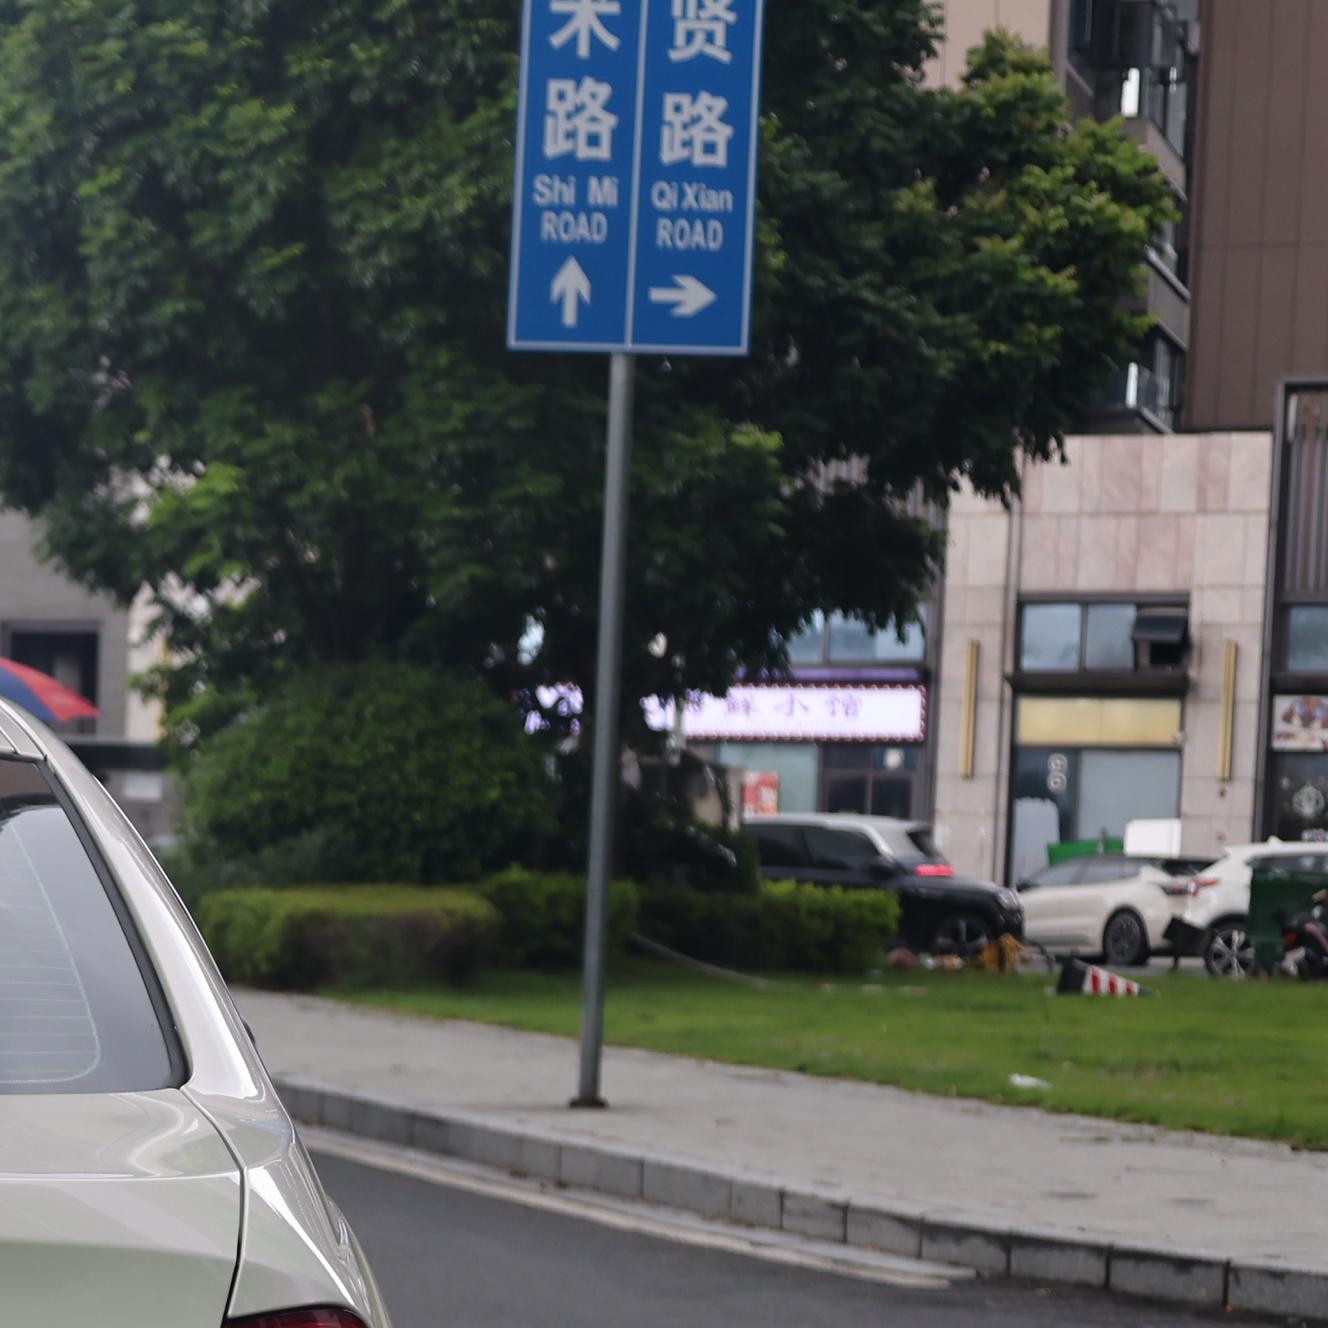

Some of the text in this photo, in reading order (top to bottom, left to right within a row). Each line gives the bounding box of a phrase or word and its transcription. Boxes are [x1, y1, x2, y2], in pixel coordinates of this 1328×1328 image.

[533, 174, 619, 208] Shi Mi
[651, 181, 733, 213] Qi Xian
[540, 211, 608, 244] ROAD
[655, 218, 723, 251] ROAD
